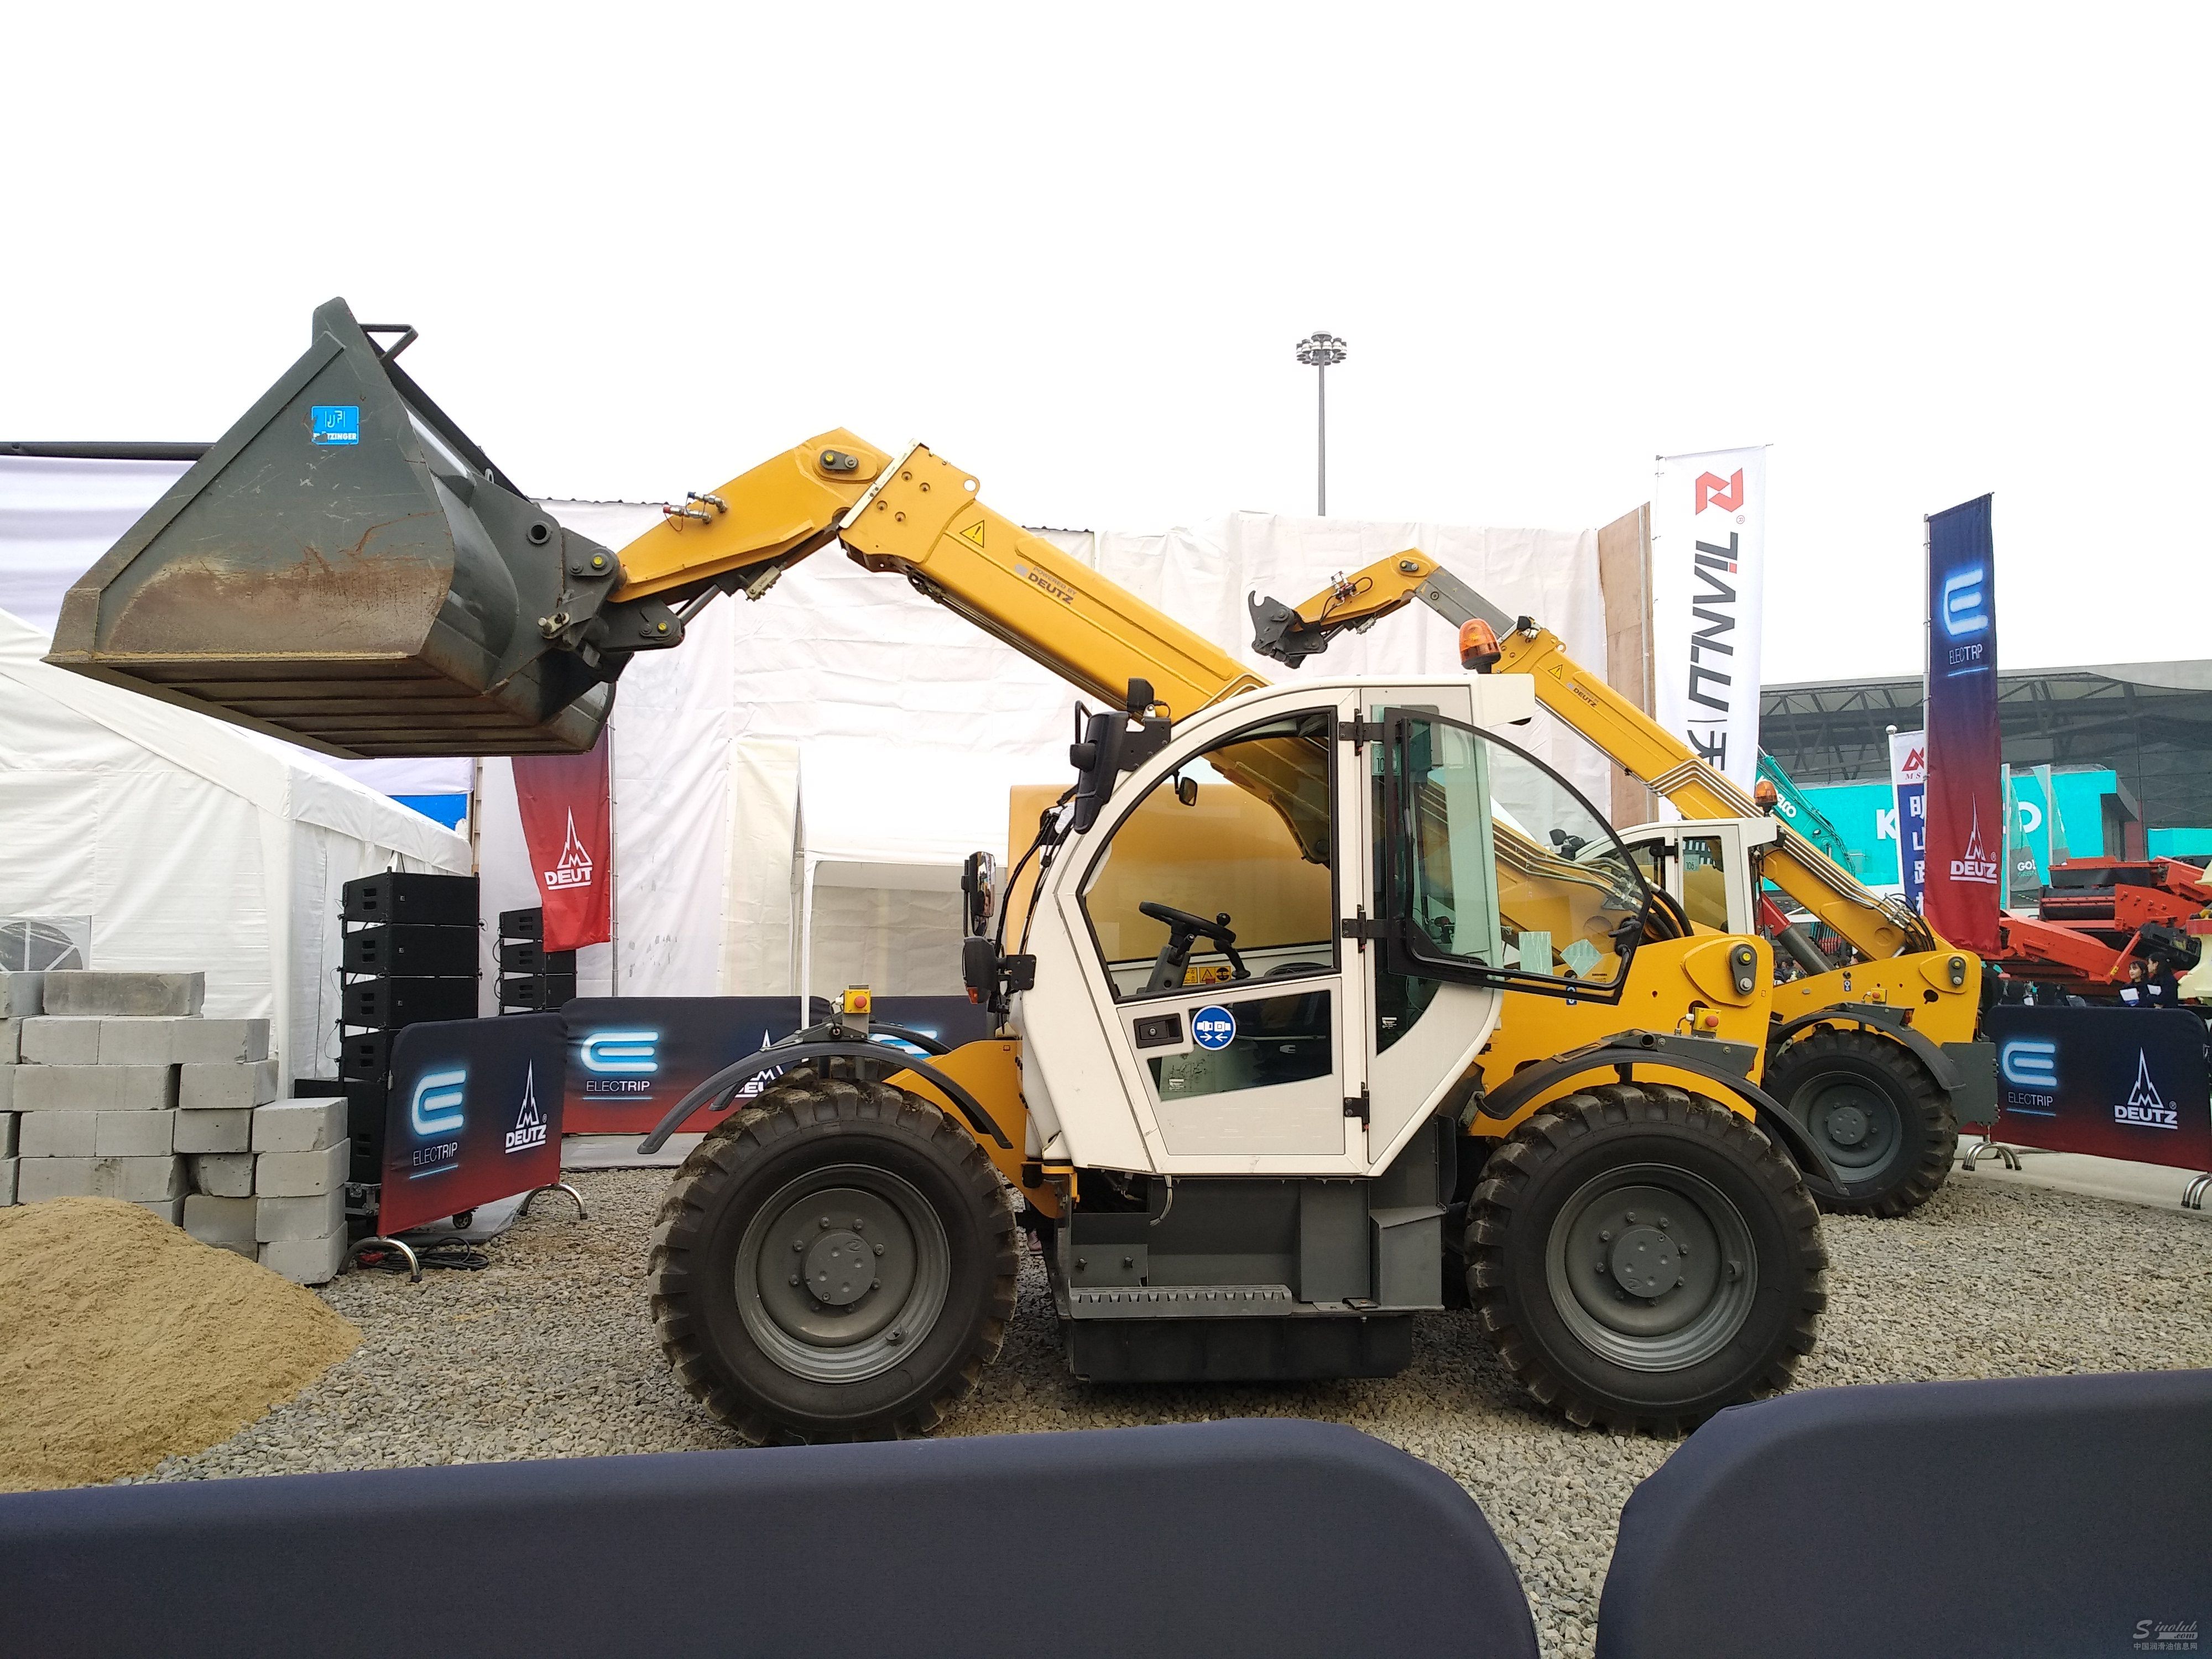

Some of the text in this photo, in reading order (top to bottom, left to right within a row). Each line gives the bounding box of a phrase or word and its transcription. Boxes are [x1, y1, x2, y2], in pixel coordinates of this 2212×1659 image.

[1028, 572, 1074, 605] DEUTZ
[1573, 687, 1597, 708] DEUTZ
[586, 1081, 650, 1092] ELECTRIP
[2008, 1092, 2053, 1107] ELECTRIP
[2114, 1105, 2178, 1125] DEUTZ
[505, 1124, 547, 1148] DEUTZ
[413, 1142, 458, 1166] ELECTRIP
